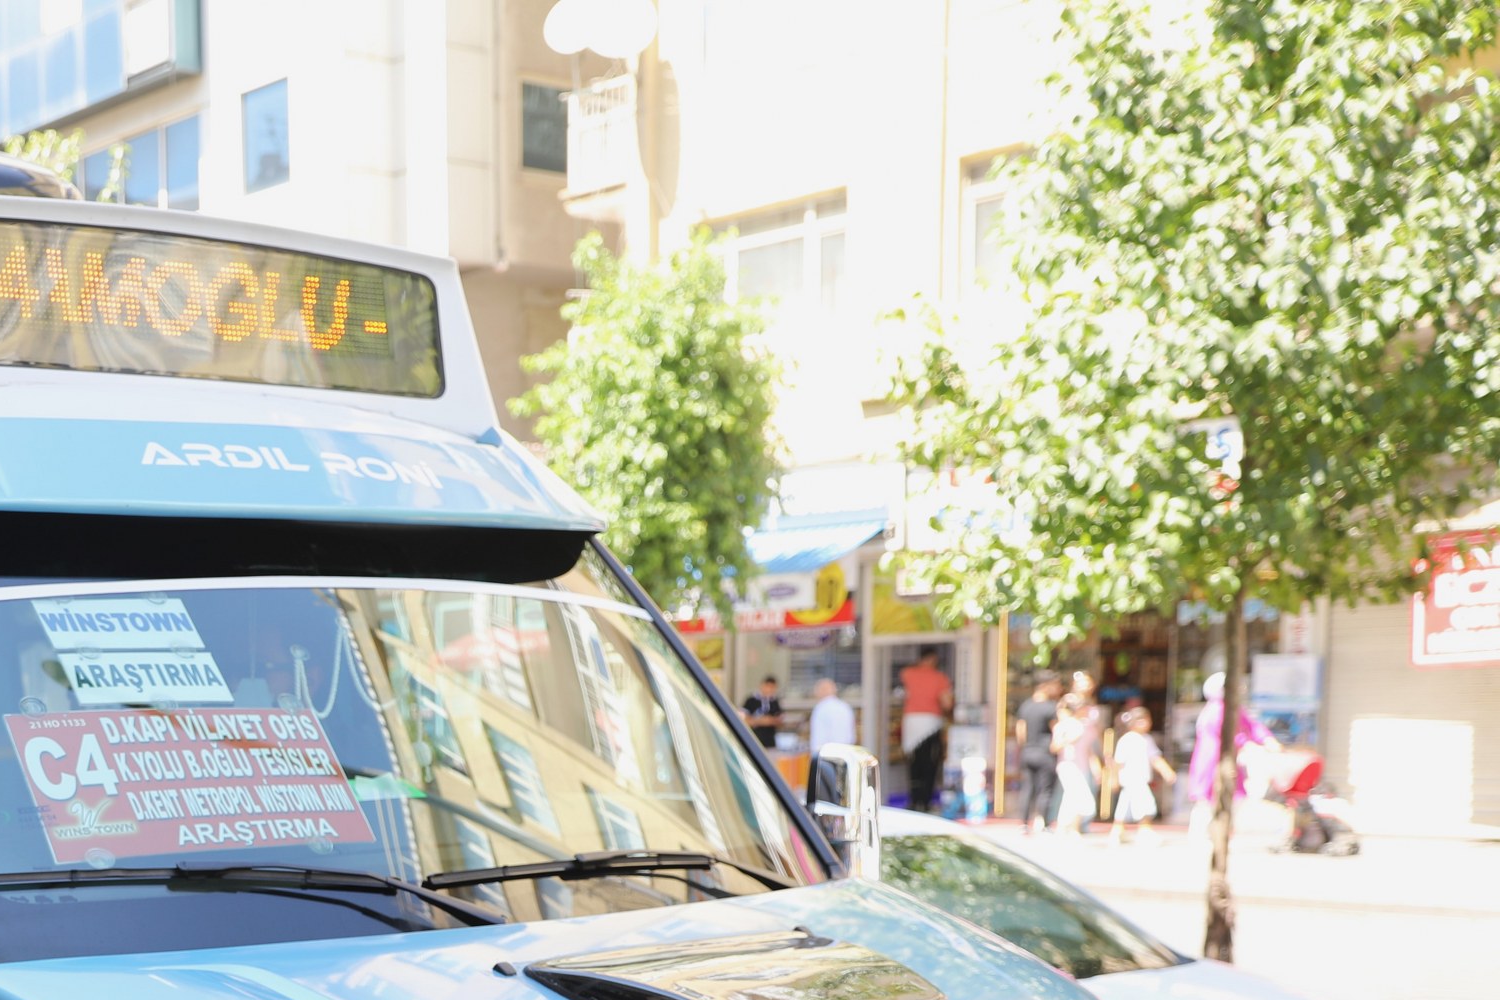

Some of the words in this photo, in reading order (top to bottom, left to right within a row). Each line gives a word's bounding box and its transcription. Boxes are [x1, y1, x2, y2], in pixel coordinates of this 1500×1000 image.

[141, 442, 310, 472] ARDIL
[41, 608, 194, 632] WİNSTOWN
[74, 664, 223, 692] ARAŞTIRMA
[29, 721, 41, 729] 21
[63, 719, 86, 727] 1133
[100, 715, 178, 744] D.KAPI
[175, 709, 267, 741] VİLAYET
[25, 734, 119, 800] C4
[114, 750, 185, 781] K.YOLU
[182, 743, 253, 779] B.OĞLU
[249, 742, 337, 776] TESİSLER
[126, 789, 186, 820] D.KENT
[181, 786, 262, 817] METROPOL
[319, 784, 355, 811] AVM
[179, 818, 338, 845] ARAŞTIRMA
